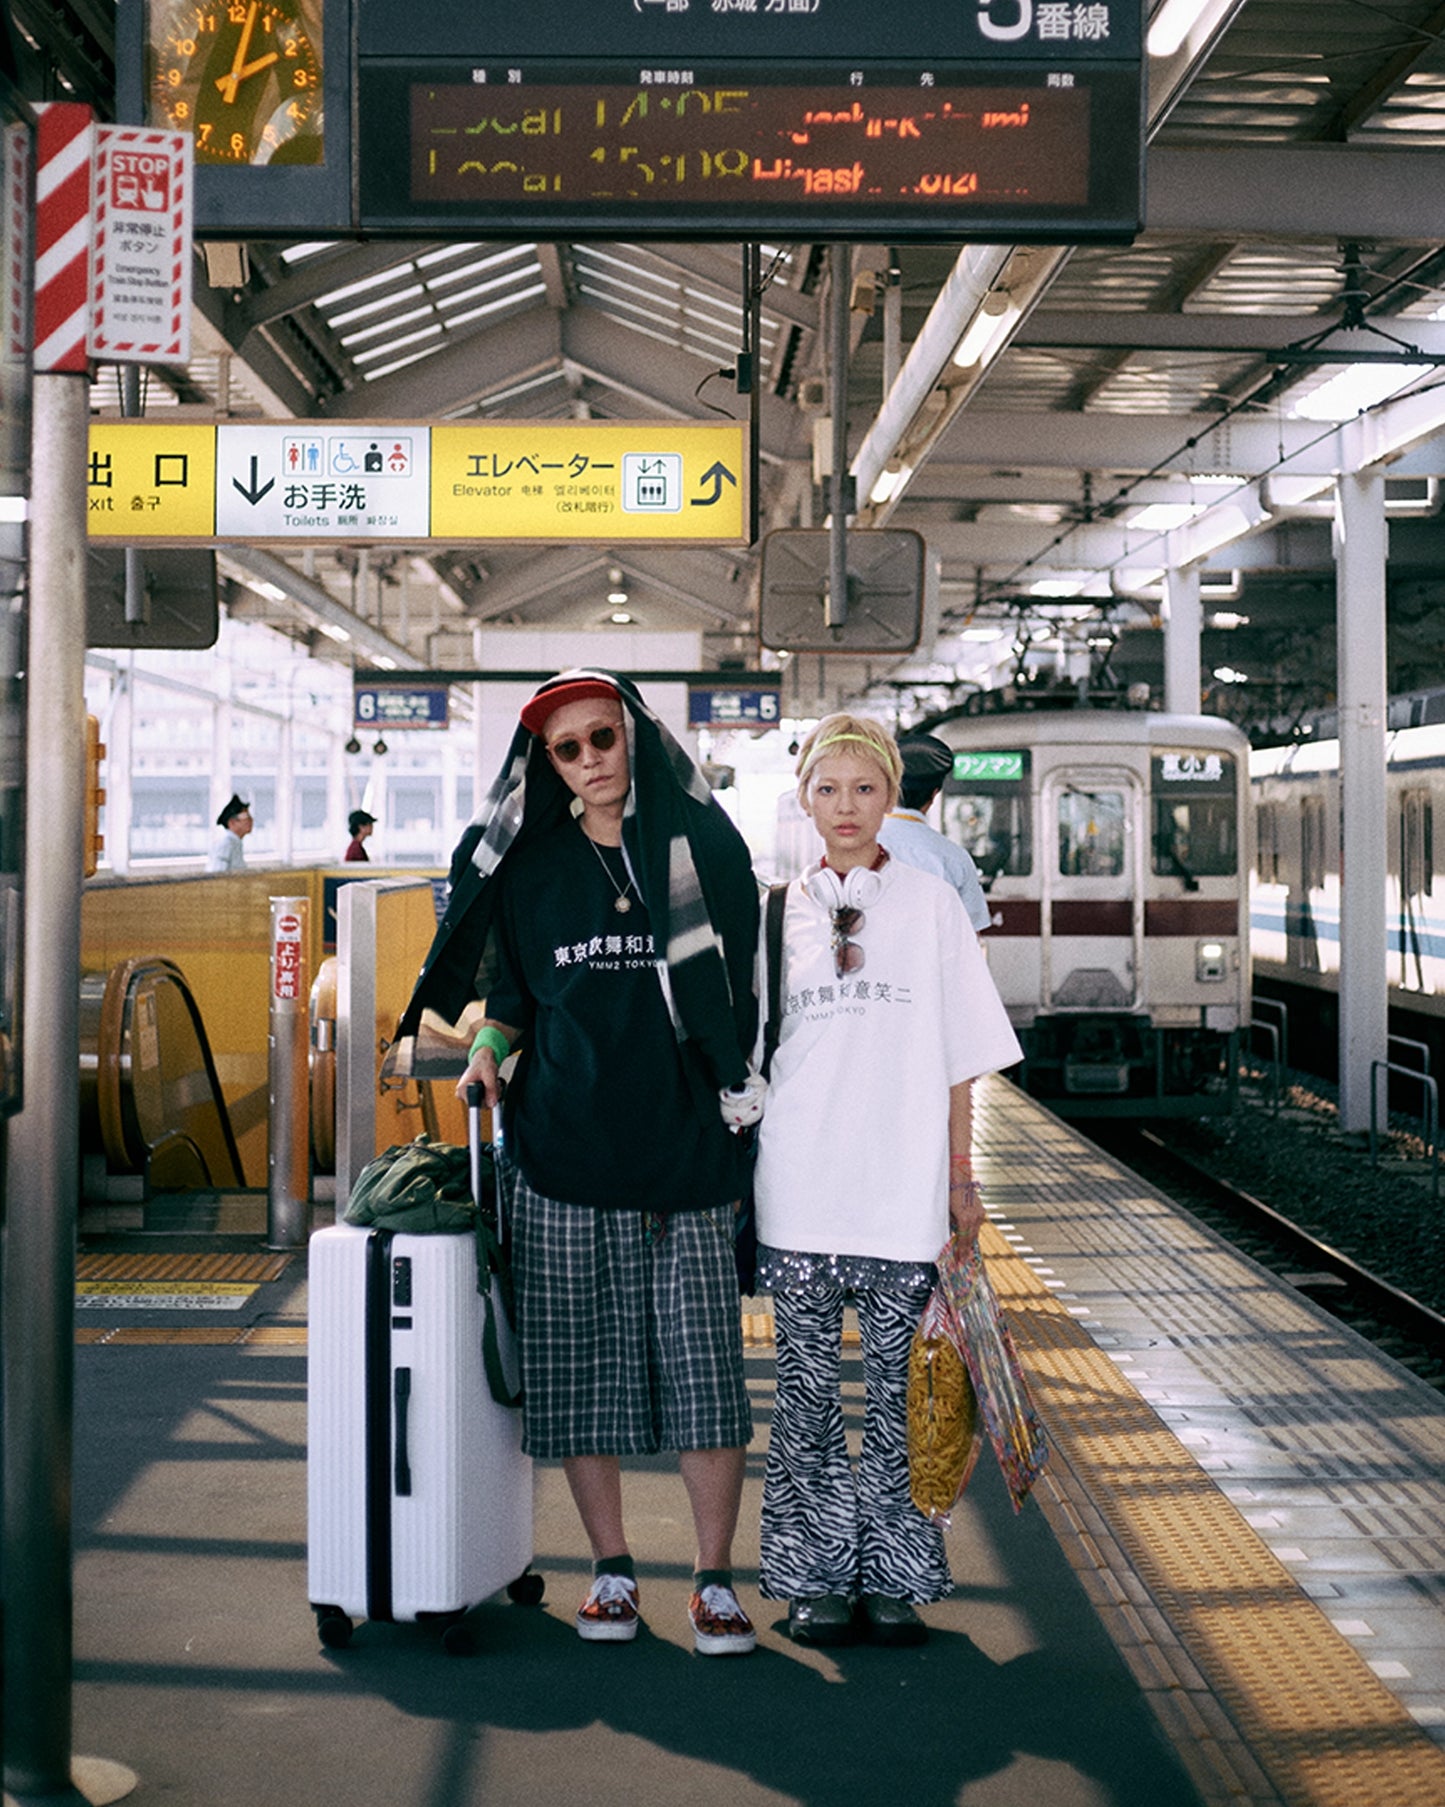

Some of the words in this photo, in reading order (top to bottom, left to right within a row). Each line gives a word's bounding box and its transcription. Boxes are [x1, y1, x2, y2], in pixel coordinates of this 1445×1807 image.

[227, 6, 246, 22] 12
[198, 15, 215, 32] 11
[262, 16, 271, 32] 1
[177, 38, 196, 56] 10
[284, 39, 297, 57] 2
[168, 69, 181, 86] 9
[293, 69, 307, 86] 3
[175, 102, 189, 119] 8
[199, 124, 212, 141] 7
[231, 133, 243, 150] 6
[112, 155, 168, 175] STOP
[113, 221, 166, 238] 非常停止
[120, 240, 158, 253] ボタン
[466, 453, 615, 478] エレベーター
[283, 483, 366, 510] お手洗
[452, 484, 512, 497] Elevator
[90, 497, 114, 511] xit
[131, 496, 161, 511] 출구
[283, 515, 330, 527] Toilets
[359, 694, 376, 720] 6
[760, 694, 778, 720] 5
[953, 755, 1022, 776] ワンマン
